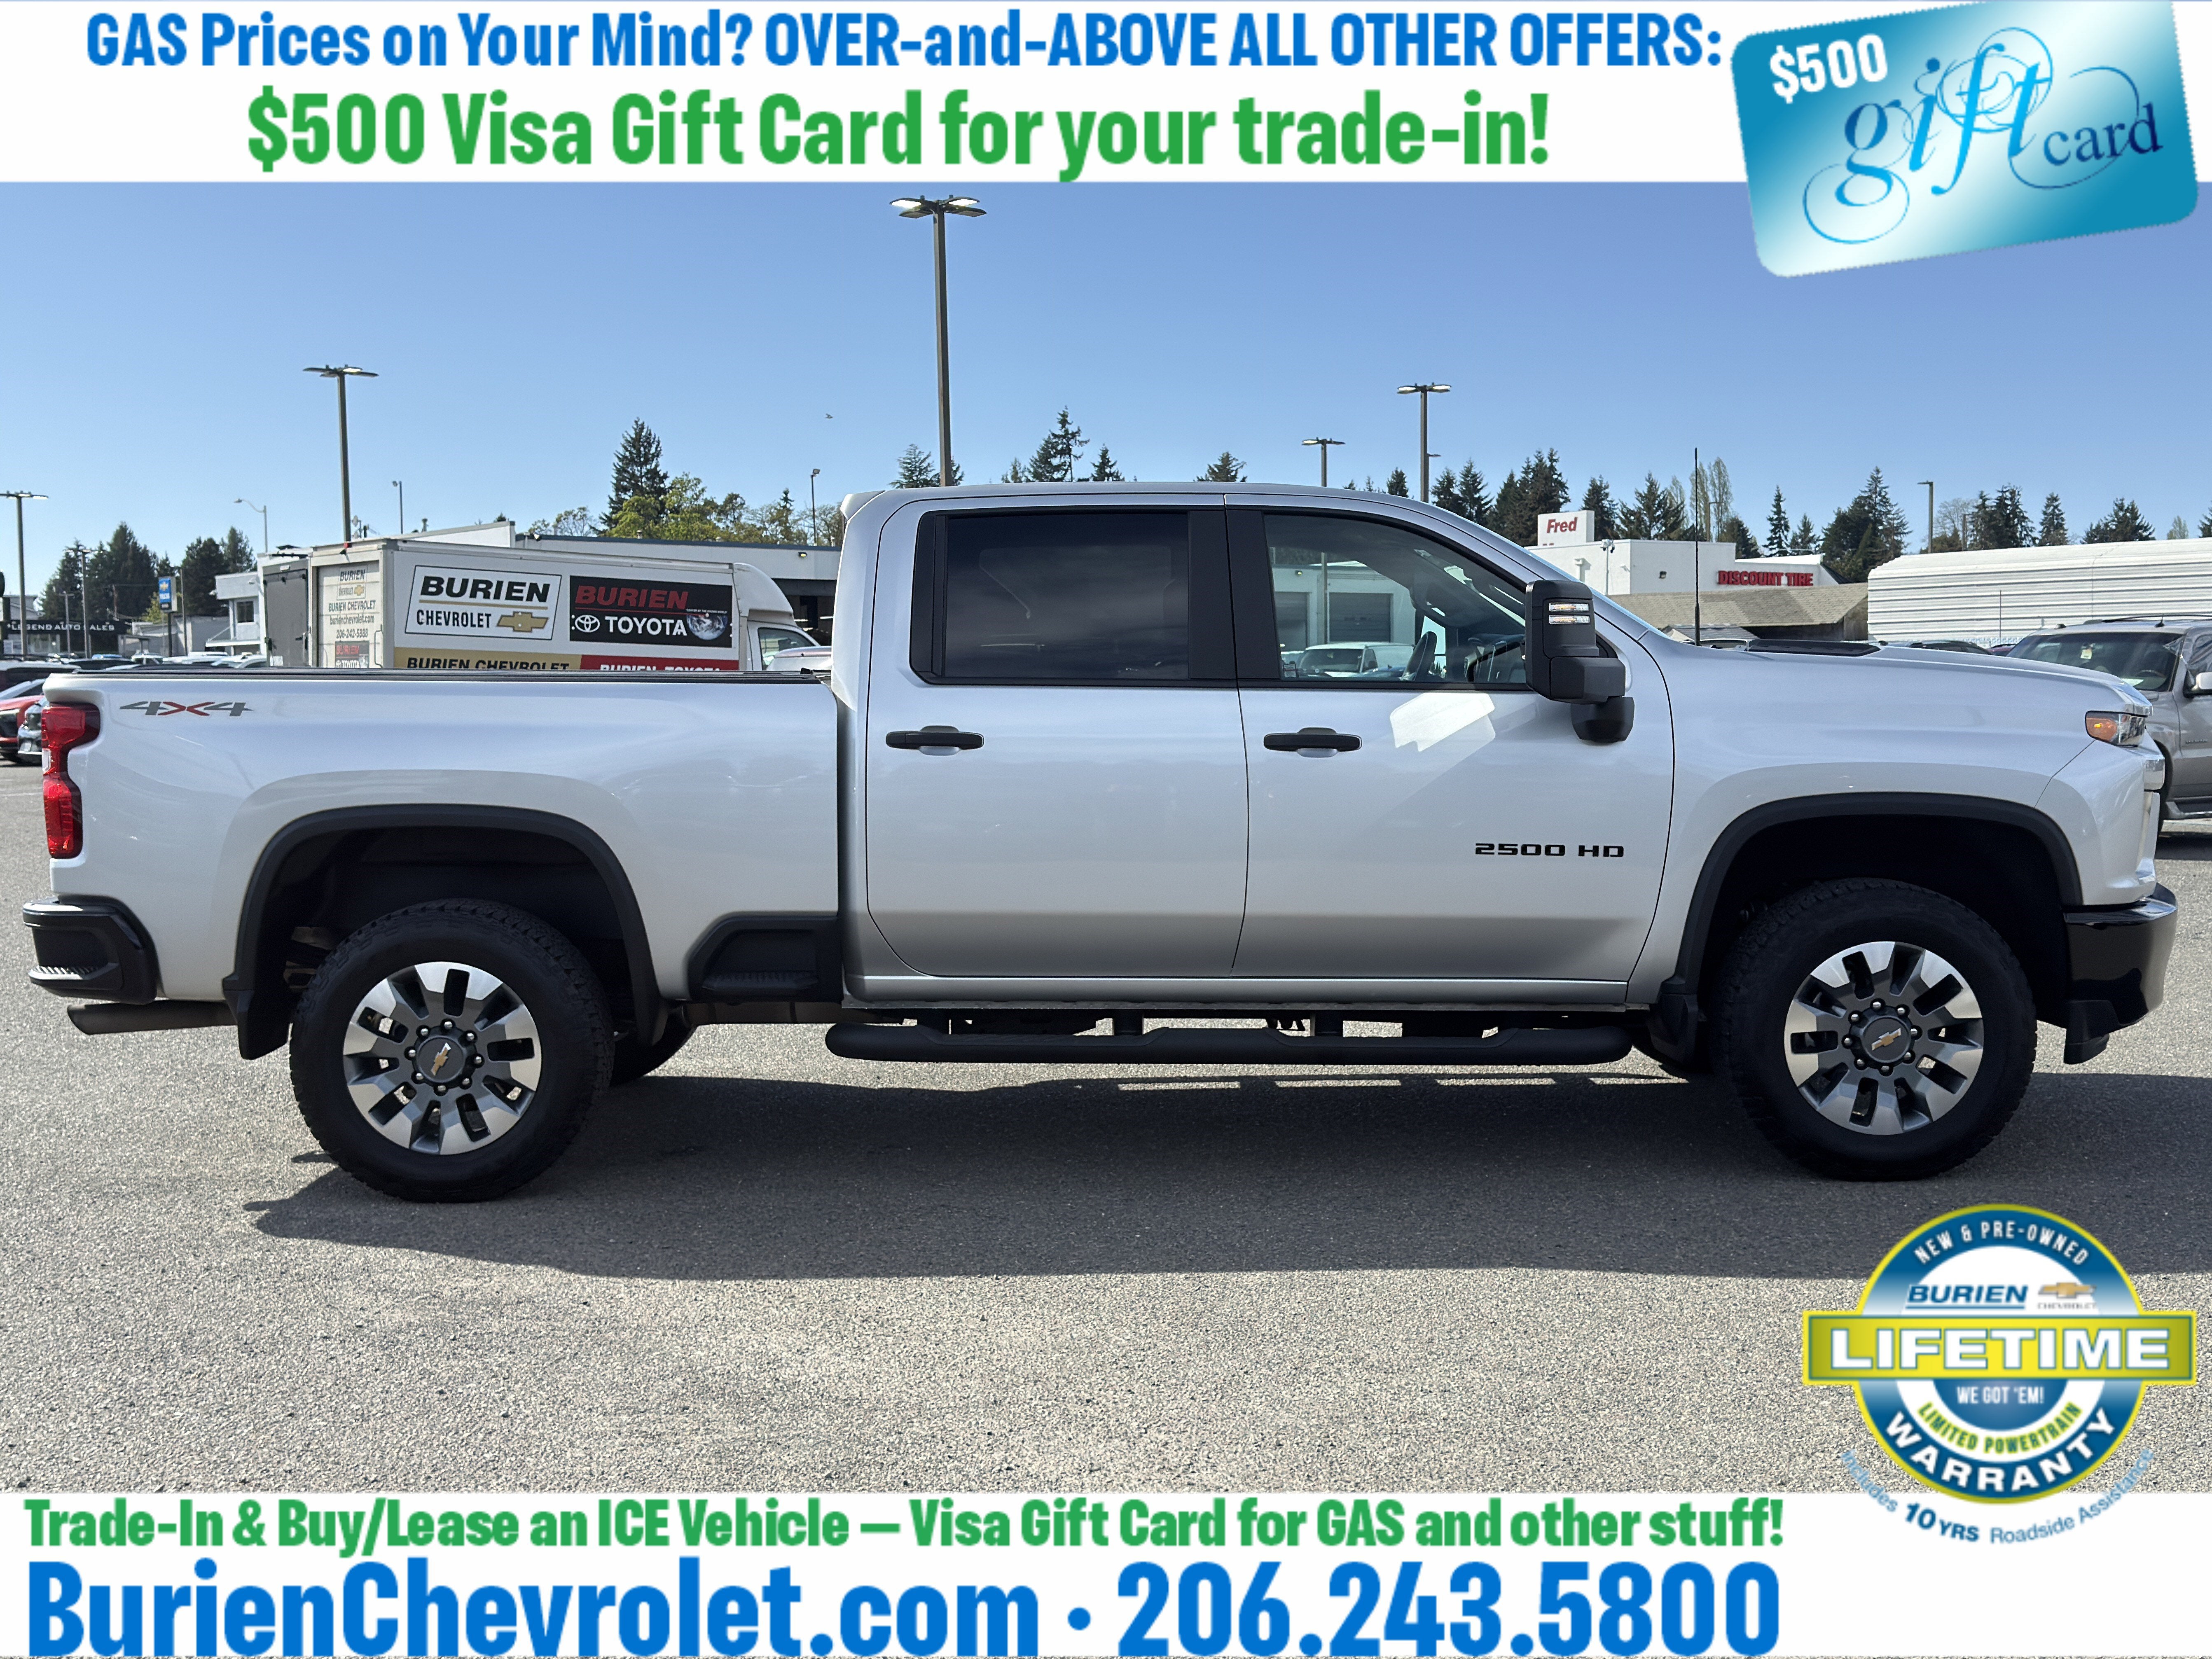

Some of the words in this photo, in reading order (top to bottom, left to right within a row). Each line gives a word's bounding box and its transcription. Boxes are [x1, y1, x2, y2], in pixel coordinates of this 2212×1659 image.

[1547, 516, 1578, 533] Fred
[340, 569, 365, 581] BURIEN
[1718, 570, 1784, 586] DISCOUNT
[1785, 572, 1813, 586] TIRE
[420, 575, 550, 603] BURIEN
[575, 585, 689, 610] BURIEN
[329, 602, 346, 612] BURIEN
[348, 600, 376, 611] CHEVROLET
[416, 609, 491, 629] CHEVROLET
[605, 616, 687, 636] TOYOTA
[341, 660, 360, 668] TOYOTA
[407, 657, 470, 668] BURIEN
[1475, 843, 1565, 856] 2500
[1578, 845, 1624, 858] HD
